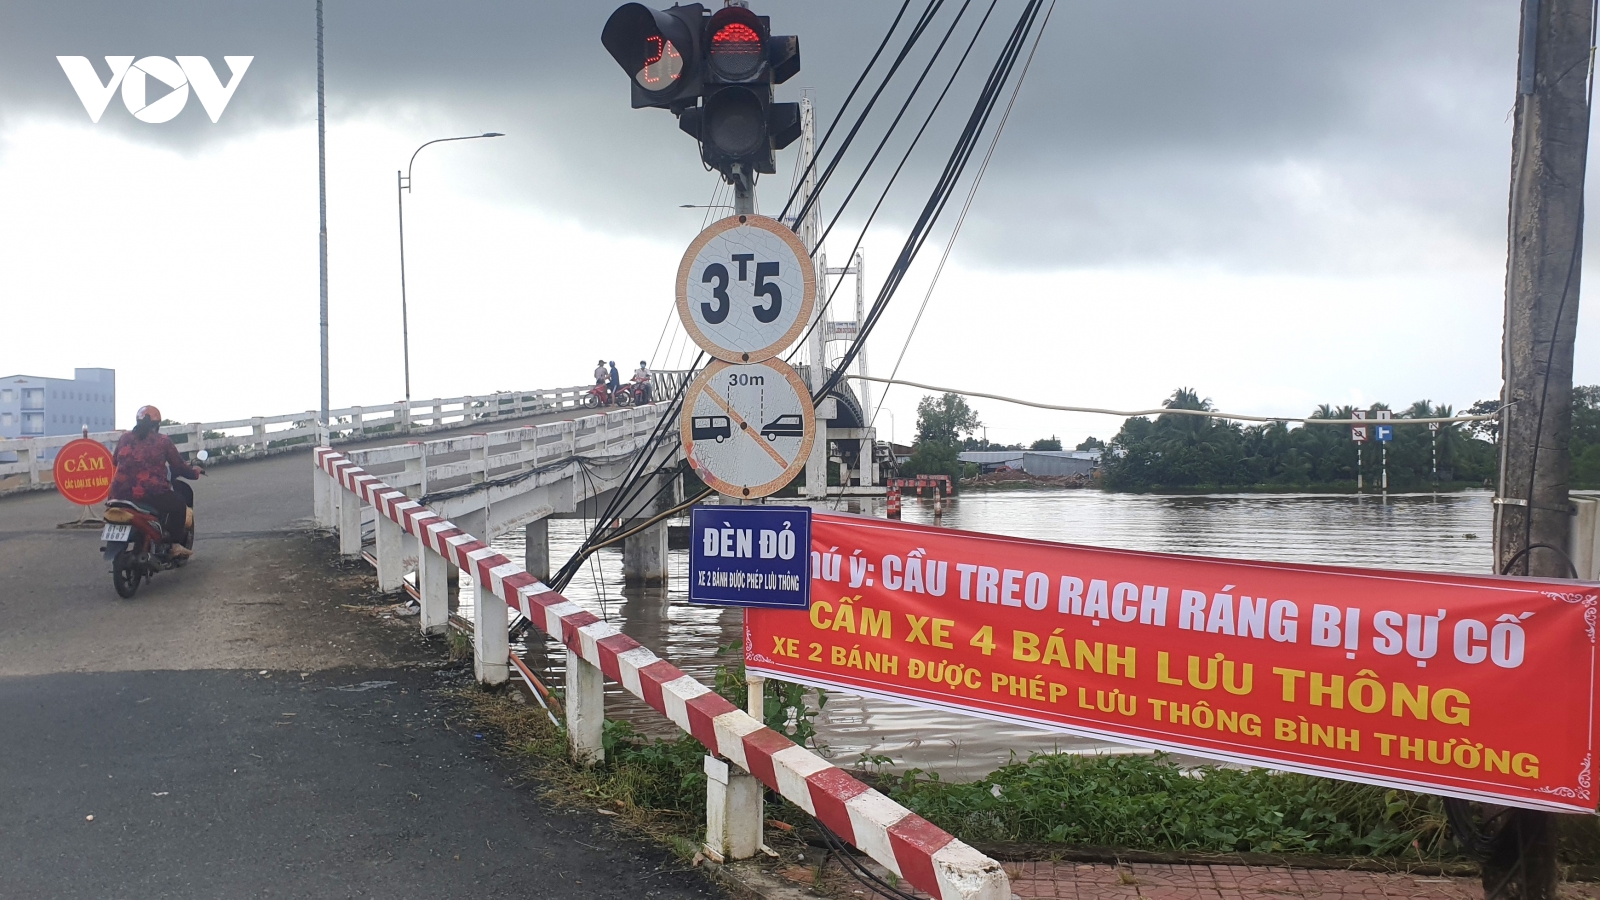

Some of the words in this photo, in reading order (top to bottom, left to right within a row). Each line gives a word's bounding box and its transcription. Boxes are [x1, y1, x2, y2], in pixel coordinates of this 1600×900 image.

[728, 373, 764, 386] 30m
[64, 452, 105, 472] CẤM
[703, 521, 753, 559] ĐÈN
[759, 520, 796, 560] ĐỎ
[698, 570, 706, 586] XE
[706, 571, 711, 587] 2
[712, 567, 728, 588] BÁNH
[729, 569, 746, 591] ĐƯỢC
[746, 568, 763, 590] PHÉP
[764, 571, 777, 591] LƯU
[778, 570, 800, 592] THÔNG
[848, 549, 875, 589] ý:
[881, 547, 948, 597] CẦU
[956, 563, 1050, 611] TREO
[1058, 575, 1170, 627] RẠCH
[1178, 584, 1299, 643] RÁNG
[1311, 603, 1361, 660] BỊ
[1373, 609, 1447, 668] SỰ
[1453, 611, 1535, 669] CỐ
[809, 595, 892, 640] CẤM
[904, 613, 956, 650] XE
[970, 625, 997, 656] 4
[1013, 628, 1137, 679] BÁNH
[1157, 650, 1254, 696] LƯU
[1273, 667, 1472, 727] THÔNG
[772, 635, 800, 659] XE
[808, 642, 824, 663] 2
[830, 644, 899, 676] BÁNH
[908, 659, 983, 691] ĐƯỢC
[991, 673, 1068, 704] PHÉP
[1078, 687, 1137, 717] LƯU
[1149, 699, 1262, 738] THÔNG
[1274, 715, 1361, 752] BÌNH
[1373, 732, 1540, 779] THƯỜNG
